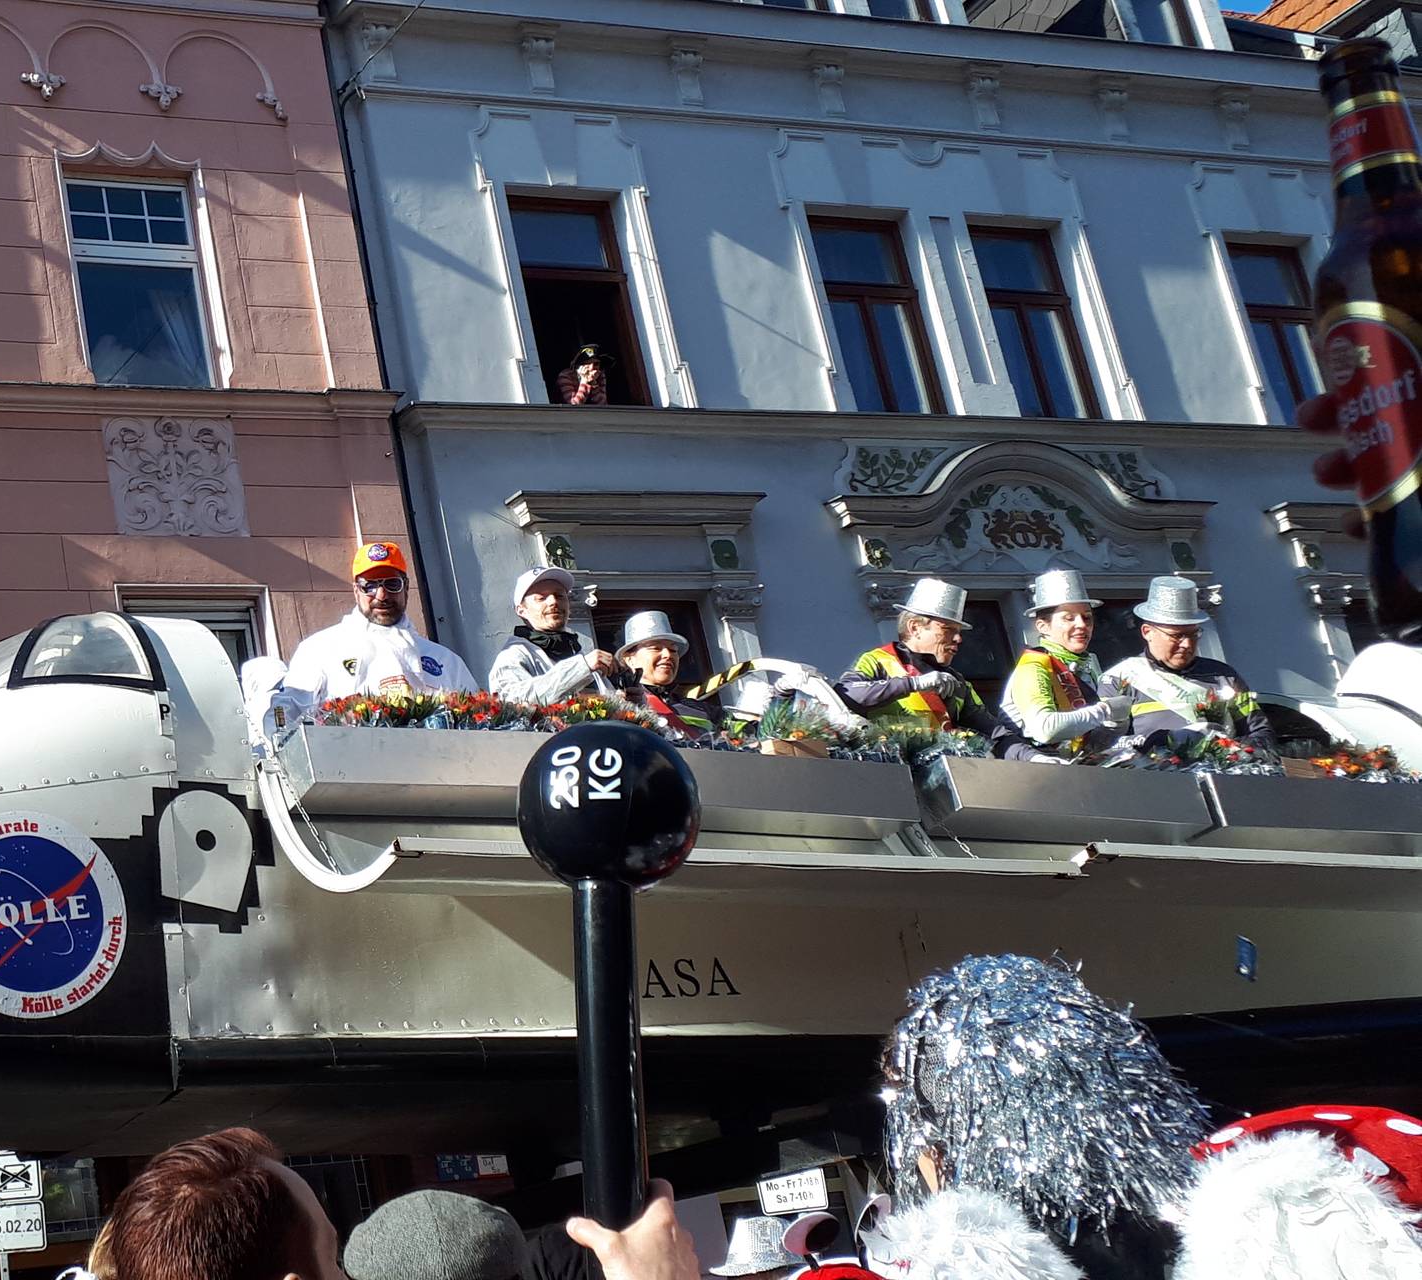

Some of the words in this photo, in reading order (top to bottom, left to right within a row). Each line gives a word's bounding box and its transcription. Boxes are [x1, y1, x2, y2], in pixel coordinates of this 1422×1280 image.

[549, 745, 582, 810] 250
[588, 747, 623, 800] KG
[22, 995, 64, 1014] Kölle
[67, 962, 110, 1006] startet
[102, 915, 123, 964] durch
[641, 957, 741, 999] ASA
[765, 1182, 780, 1192] Mo
[786, 1179, 796, 1189] Fr
[776, 1194, 788, 1204] Sa
